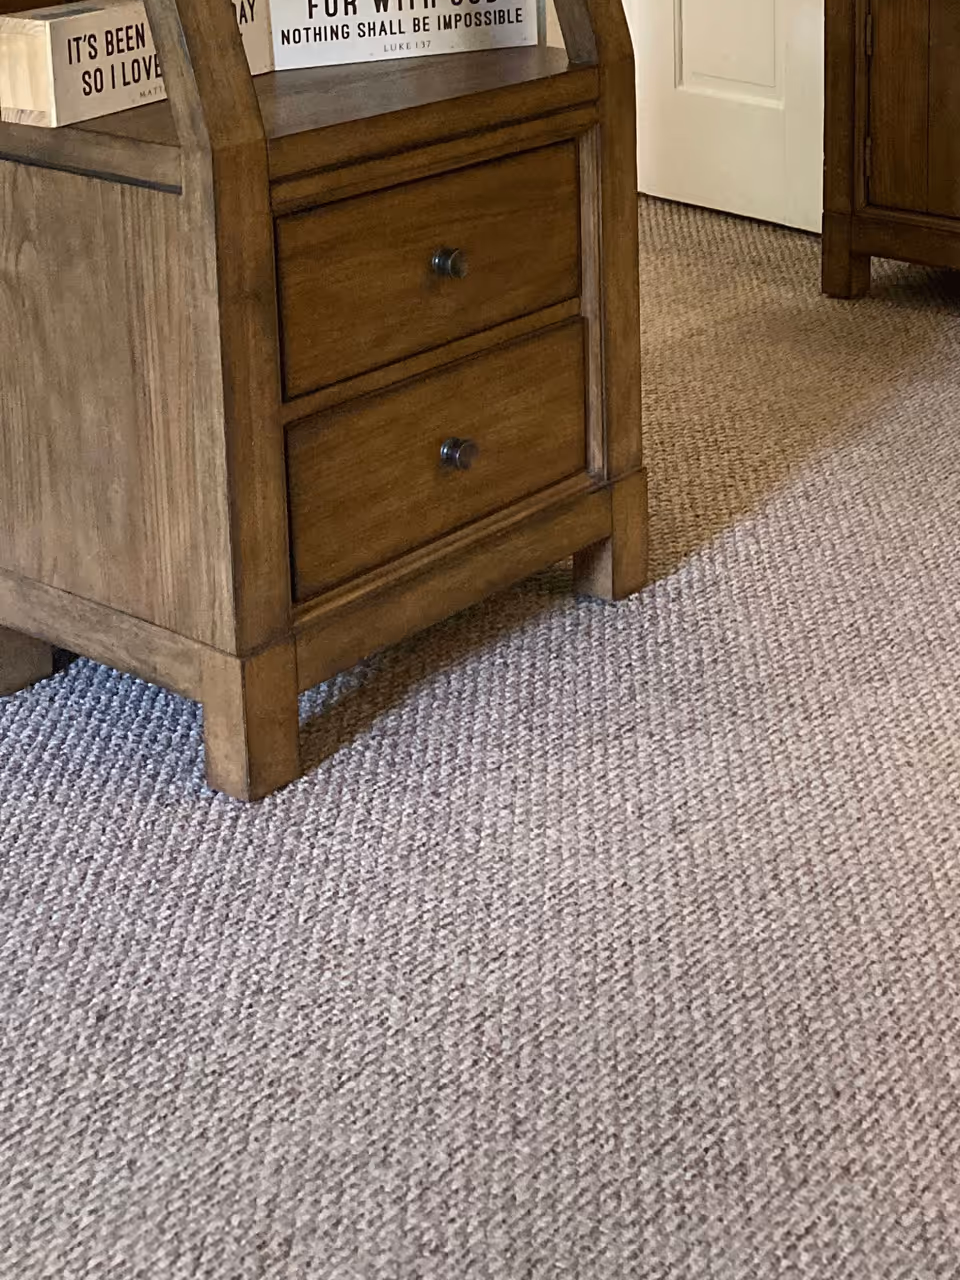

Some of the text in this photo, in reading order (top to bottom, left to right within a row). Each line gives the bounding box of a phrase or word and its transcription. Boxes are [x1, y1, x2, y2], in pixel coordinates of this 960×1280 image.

[67, 33, 98, 65] IT'S
[105, 22, 146, 57] BEEN
[281, 7, 523, 45] NOTHING SHALL BE IMPOSSIBLE
[383, 42, 411, 53] LUKE
[82, 68, 103, 97] SO
[111, 63, 116, 90] I
